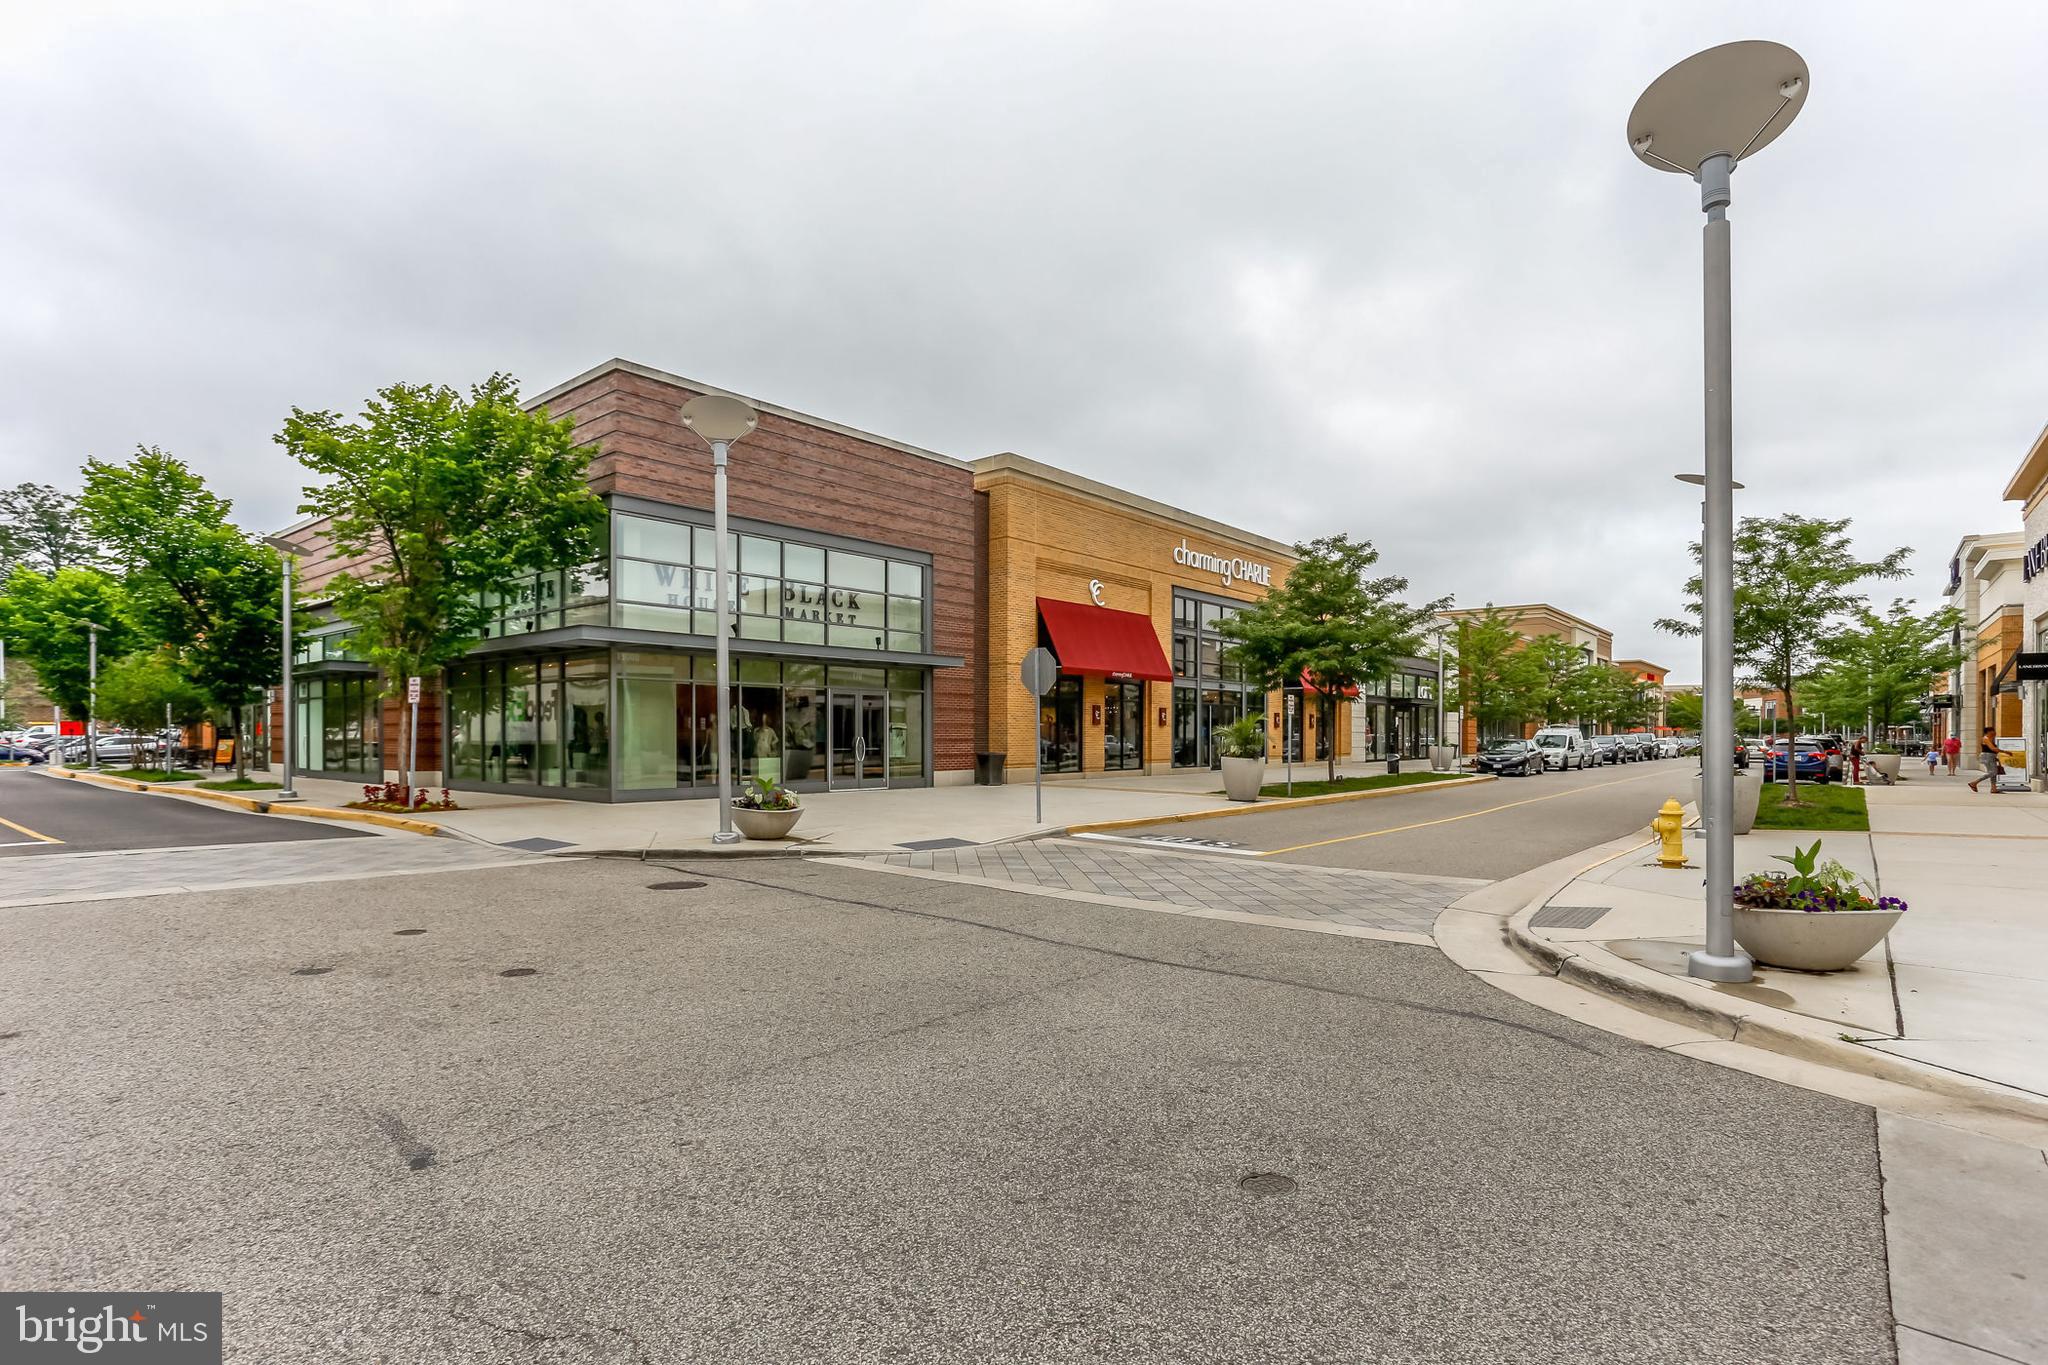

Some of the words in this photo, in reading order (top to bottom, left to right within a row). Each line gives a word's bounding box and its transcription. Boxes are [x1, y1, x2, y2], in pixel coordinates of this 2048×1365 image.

[654, 564, 750, 596] WHIE
[666, 593, 736, 613] HOUE
[784, 582, 861, 610] BLACK
[784, 606, 857, 625] MARKET
